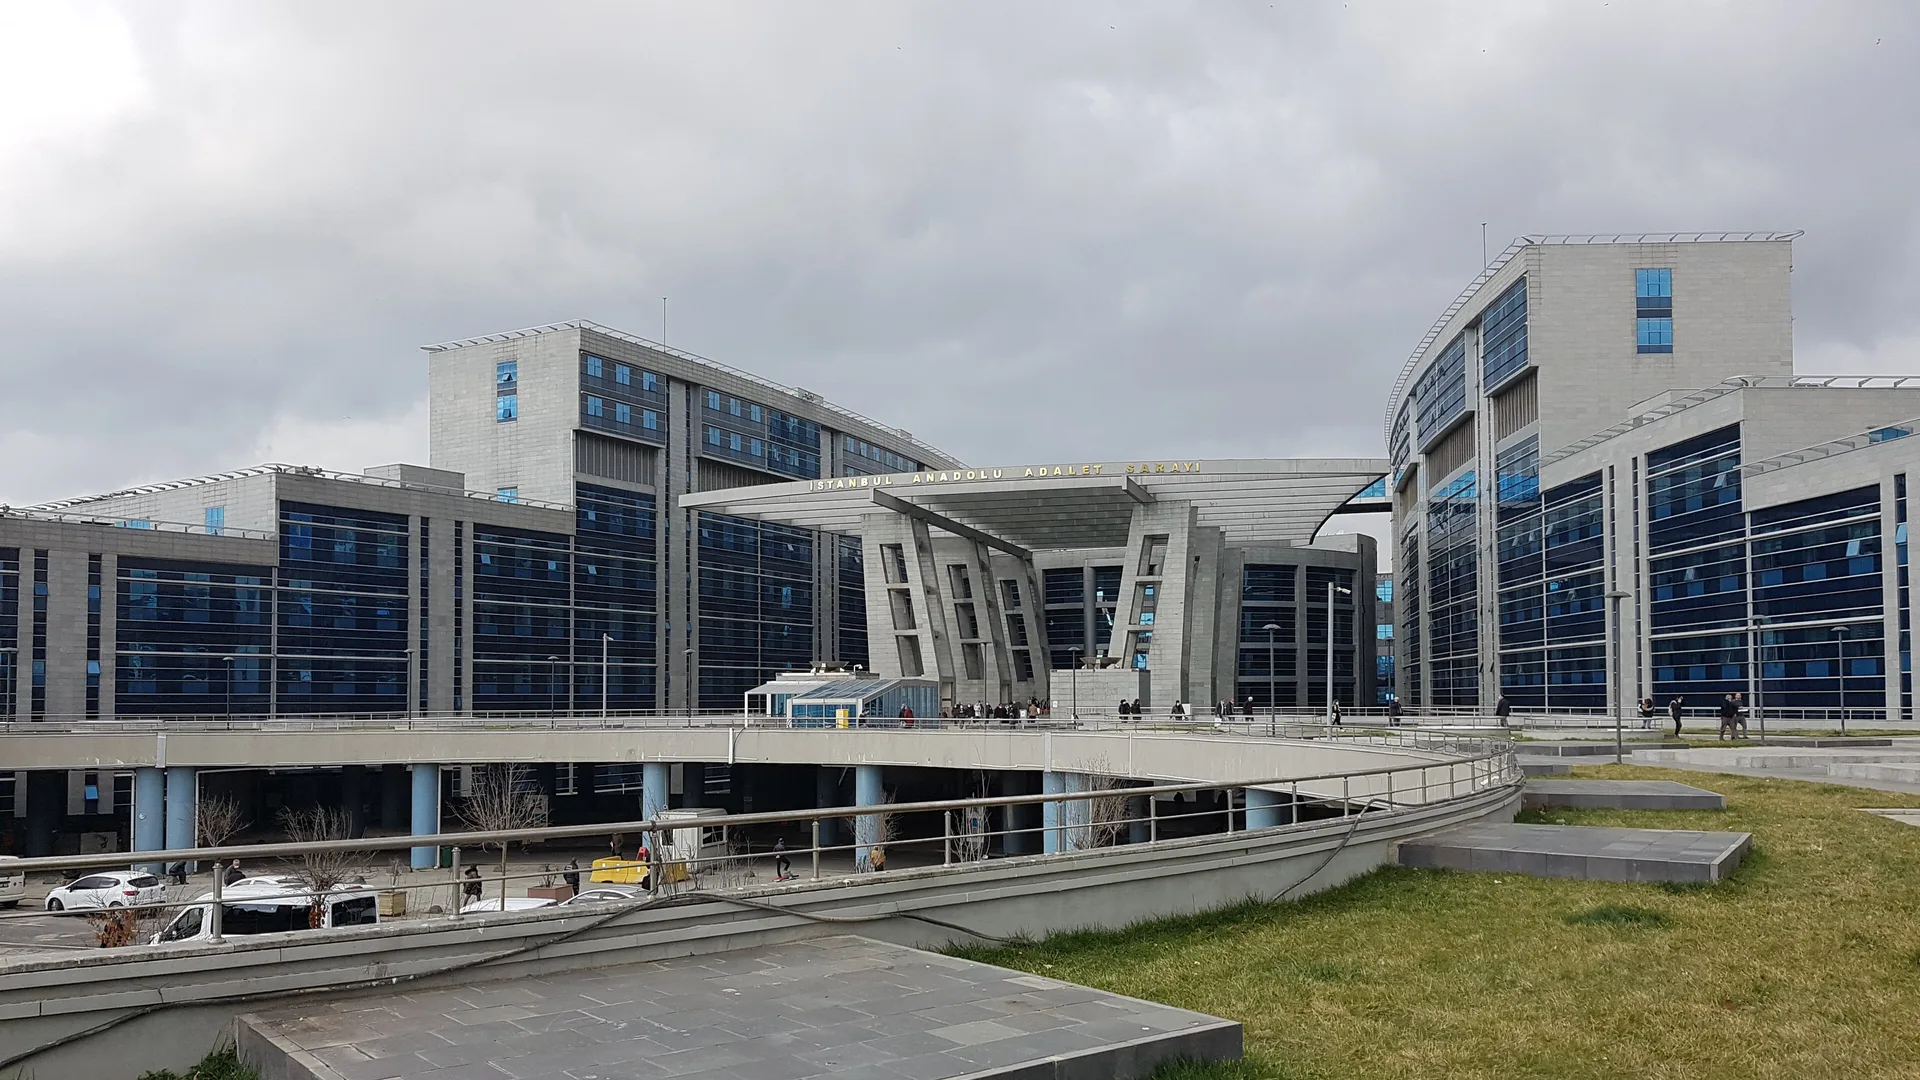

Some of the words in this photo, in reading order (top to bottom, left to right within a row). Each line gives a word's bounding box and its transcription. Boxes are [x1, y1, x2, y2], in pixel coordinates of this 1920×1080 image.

[912, 469, 1002, 483] ANADOLU
[1024, 465, 1103, 477] ADALET
[1125, 462, 1200, 474] SARAYI
